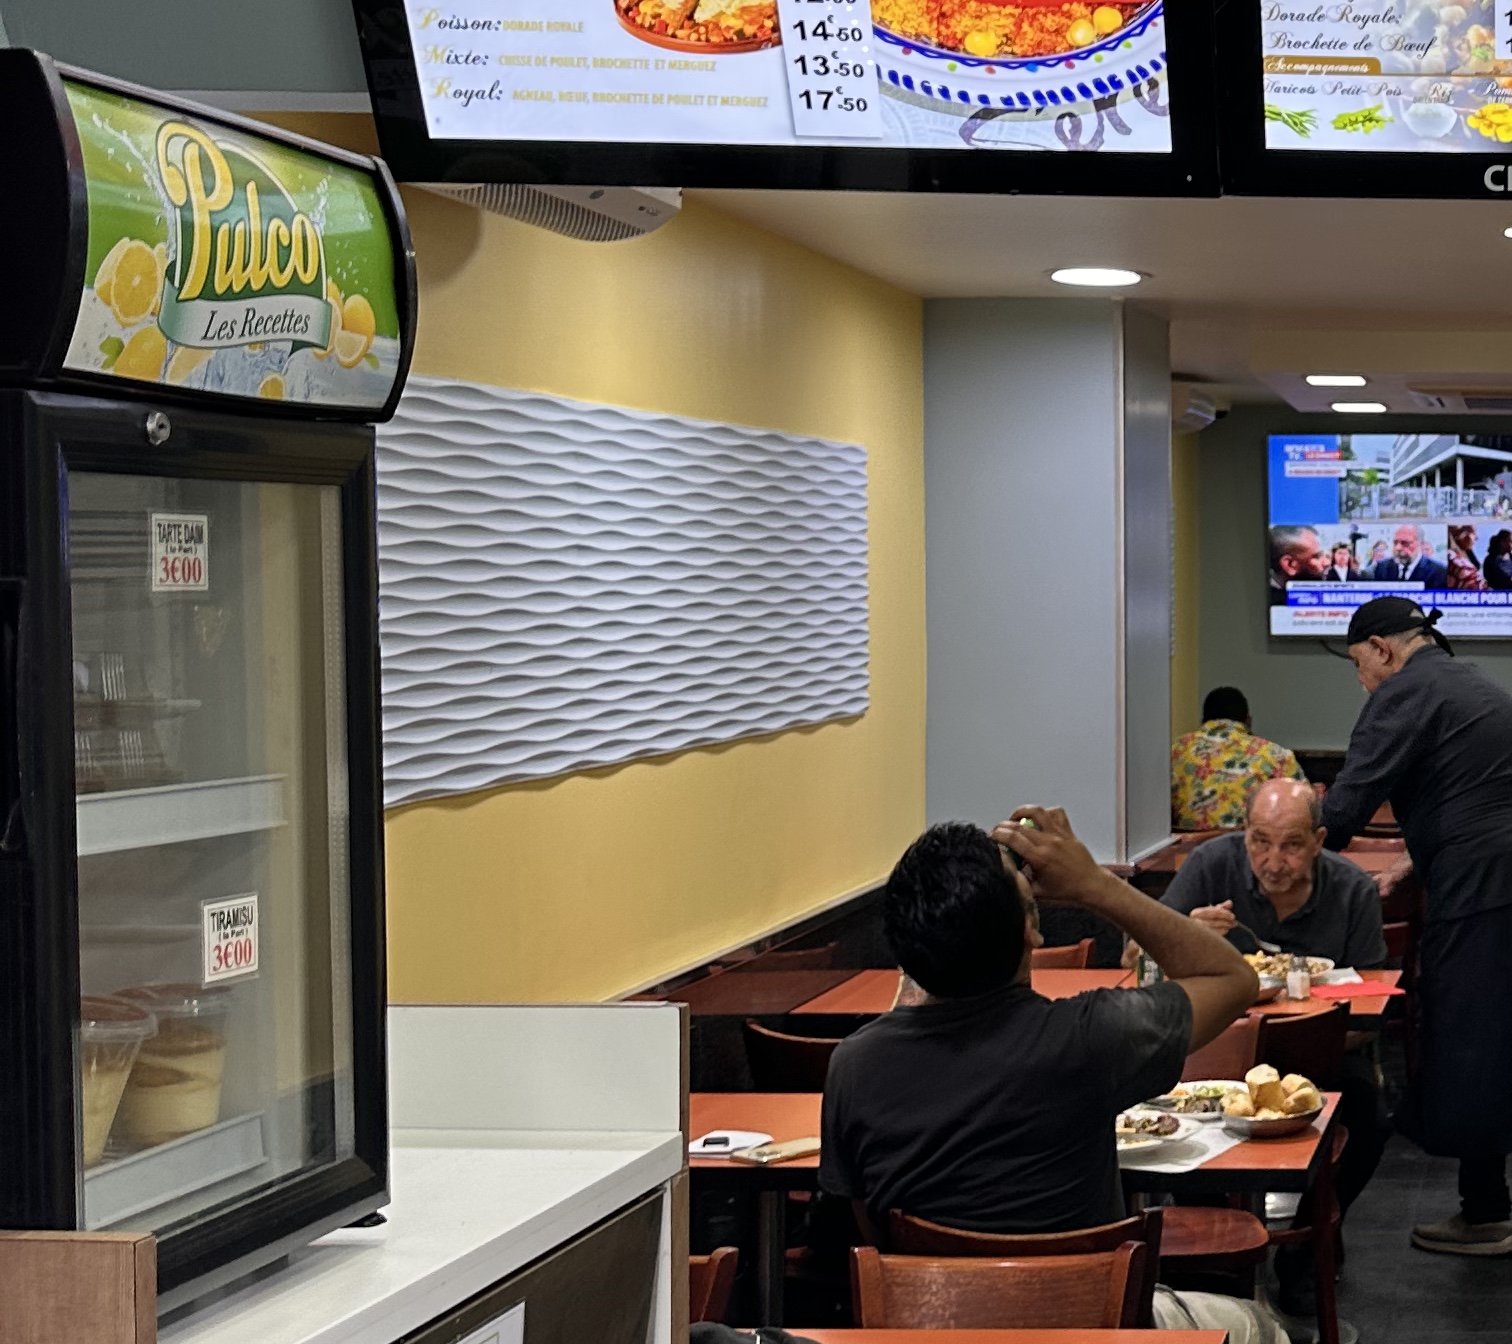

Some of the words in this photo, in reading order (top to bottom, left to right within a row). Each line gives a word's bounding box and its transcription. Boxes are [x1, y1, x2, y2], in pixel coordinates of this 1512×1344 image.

[415, 7, 502, 32] Poisson:
[1261, 5, 1326, 23] Dorade
[1325, 0, 1402, 29] Royale:
[424, 44, 489, 66] Mixte:
[1262, 32, 1347, 50] Brochette
[1353, 35, 1372, 50] de
[1378, 32, 1437, 58] Bœuf
[430, 78, 503, 107] Royal:
[156, 121, 320, 300] Pulco
[202, 310, 236, 342] Les
[239, 306, 310, 339] Recettes
[157, 523, 182, 544] TARTE
[160, 556, 202, 583] 3€00
[1480, 592, 1507, 604] POUR
[211, 905, 253, 932] TIRAMISU
[213, 938, 252, 971] 3€00
